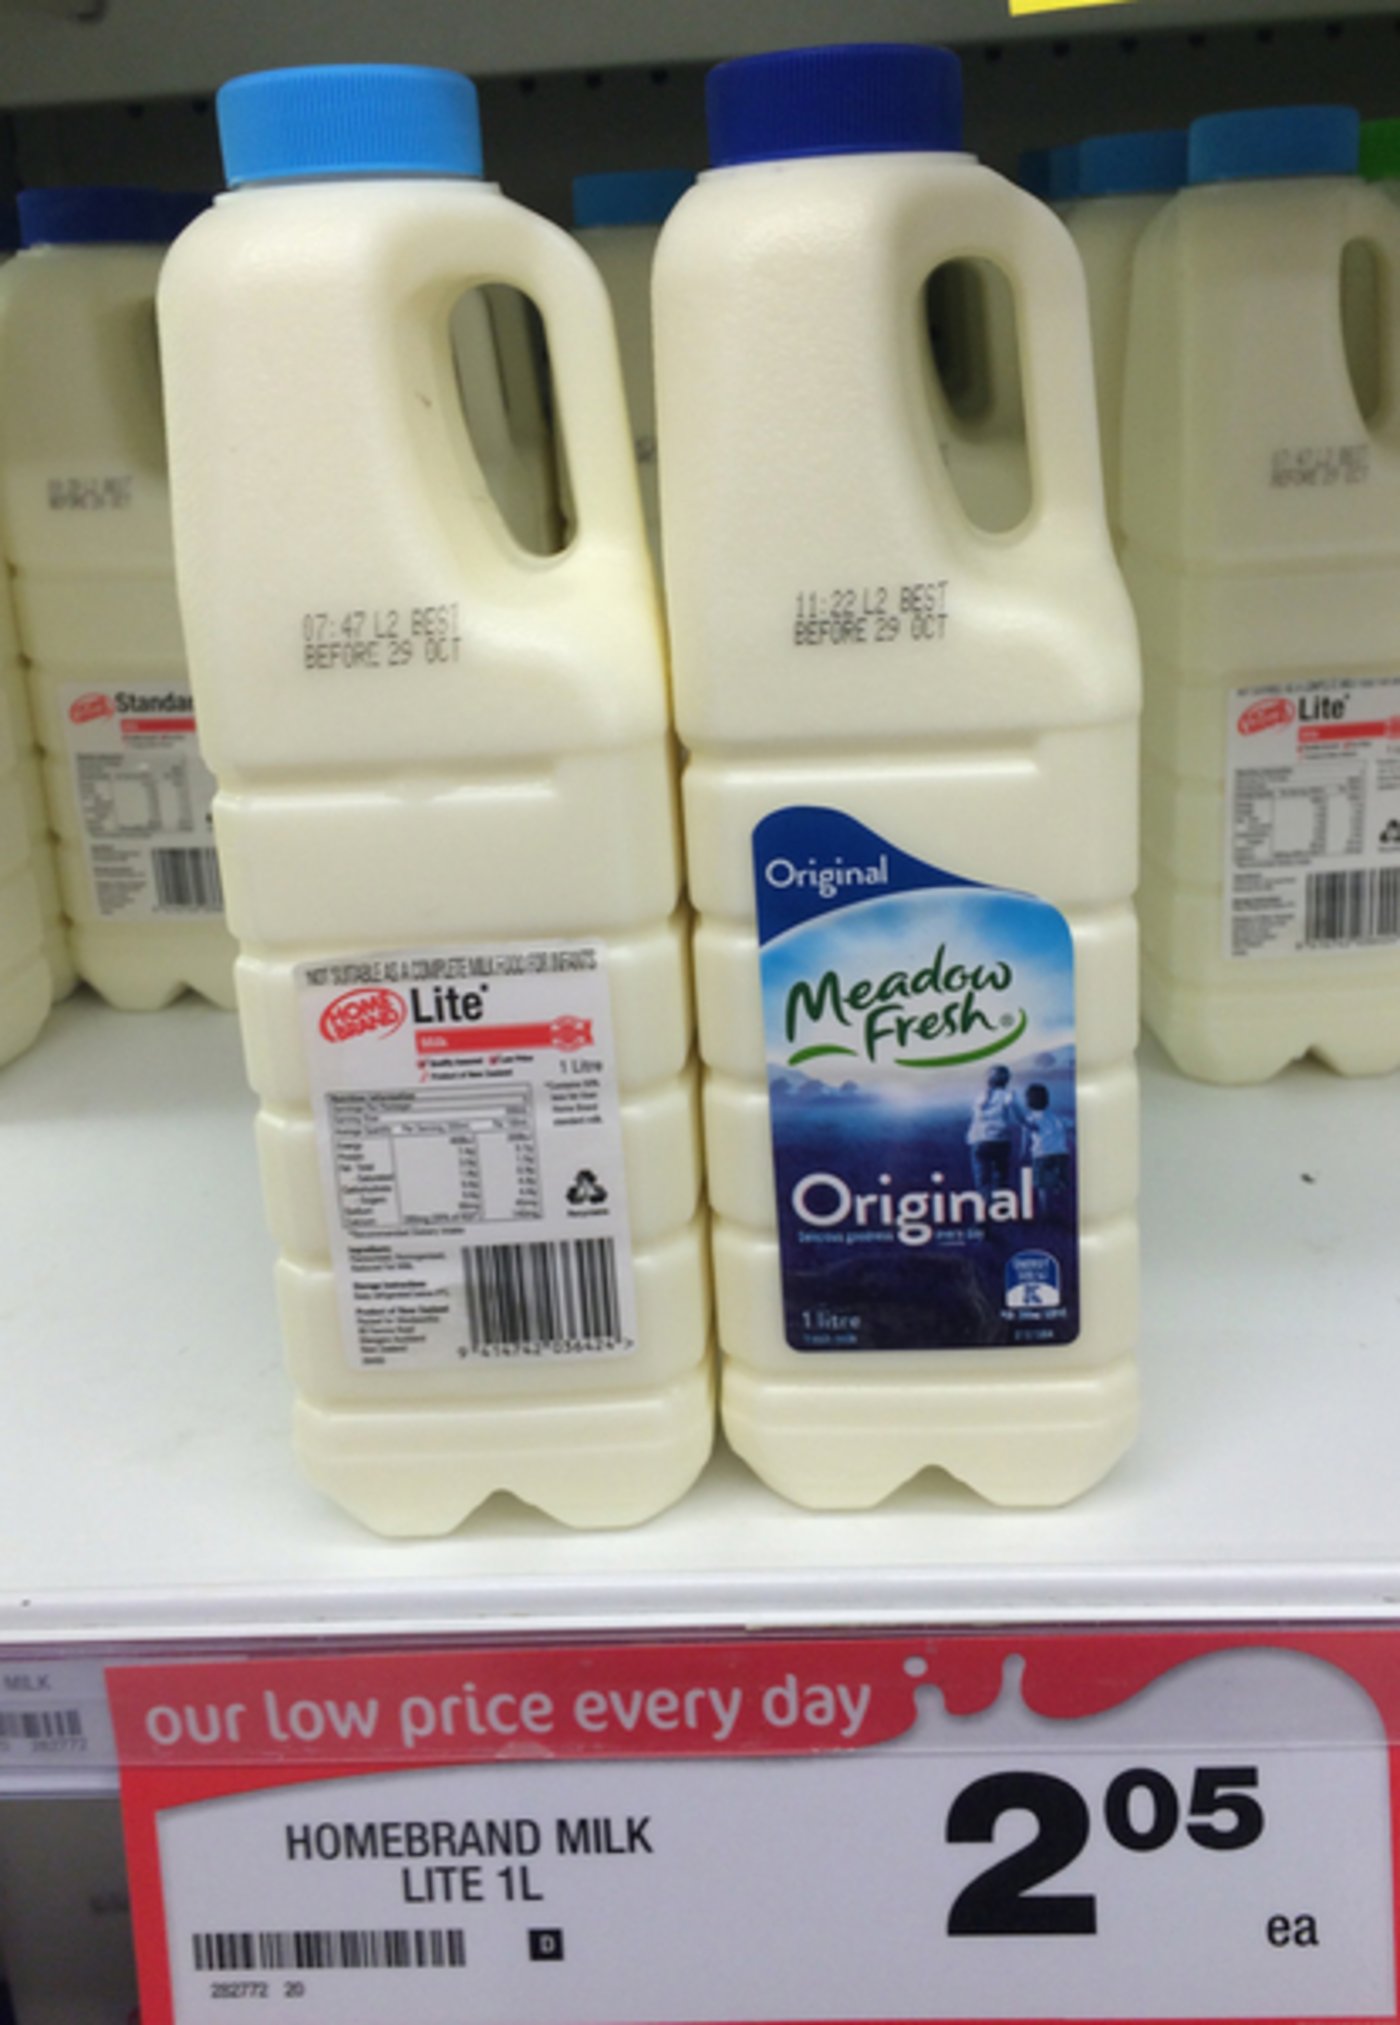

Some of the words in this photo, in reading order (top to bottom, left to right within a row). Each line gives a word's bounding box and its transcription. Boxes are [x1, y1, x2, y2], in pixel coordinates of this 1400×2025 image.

[796, 590, 857, 618] 11:22
[864, 587, 887, 615] L2
[901, 580, 948, 612] BEST
[303, 612, 366, 641] 07:47
[374, 610, 398, 638] L2
[412, 603, 459, 636] BEST
[795, 617, 867, 646] BEFORE
[875, 617, 900, 641] 29
[911, 613, 948, 641] OCT
[305, 641, 380, 669] BEFORE
[388, 639, 412, 666] 29
[425, 637, 461, 663] OCT
[765, 854, 888, 898] Original
[786, 941, 1013, 1044] Meadow
[560, 1059, 568, 1076] 1
[792, 1166, 1034, 1246] Original
[146, 1703, 246, 1746] our
[263, 1689, 380, 1742] low
[400, 1681, 554, 1749] price
[573, 1687, 743, 1742] every
[762, 1673, 872, 1737] day
[285, 1818, 542, 1861] HOMEBRAND
[556, 1815, 655, 1855] MILK
[945, 1770, 1098, 1937] 2
[1104, 1765, 1265, 1853] 05
[402, 1865, 485, 1904] LITE
[497, 1863, 544, 1902] 1L
[1266, 1912, 1320, 1948] ea
[210, 1981, 268, 1999] 282772
